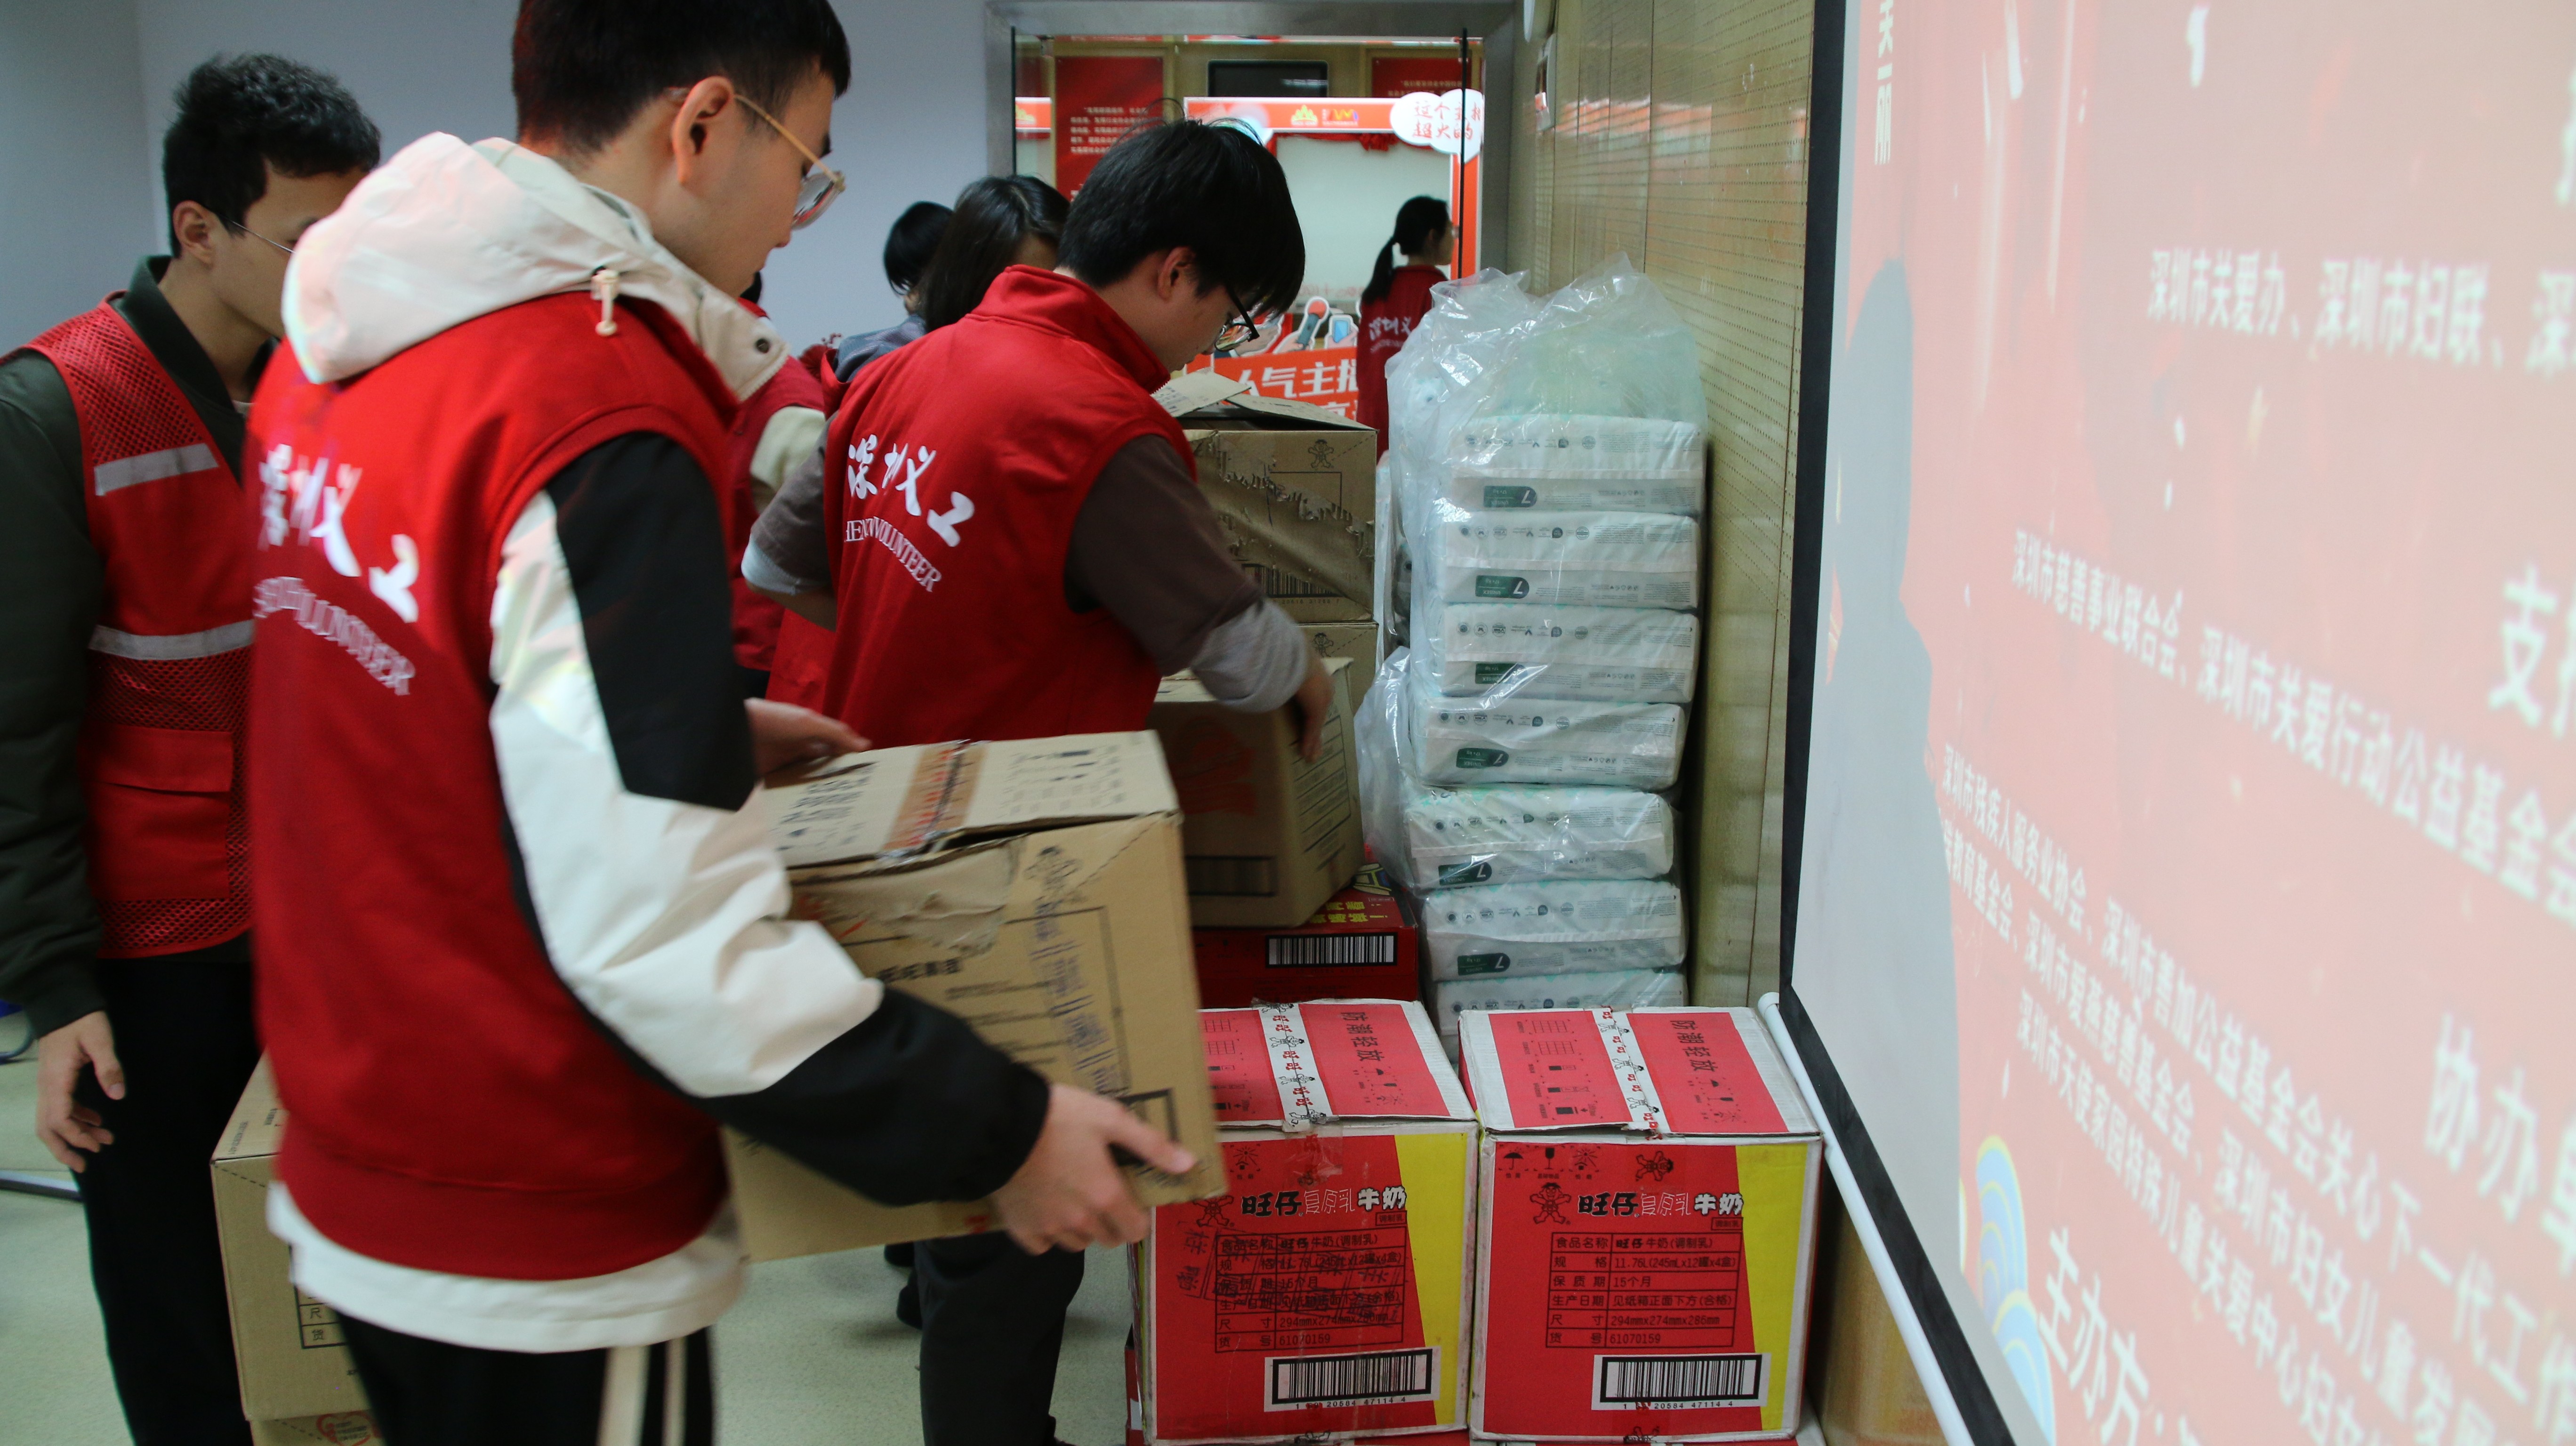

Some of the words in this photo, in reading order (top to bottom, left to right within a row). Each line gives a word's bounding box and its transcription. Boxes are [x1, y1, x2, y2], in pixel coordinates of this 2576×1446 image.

[1521, 490, 1530, 504] 7
[1513, 581, 1522, 594] 7
[1493, 754, 1502, 763] 7
[1476, 864, 1486, 877] 7
[1494, 956, 1504, 968] 7
[1340, 1012, 1384, 1062] 防潮轻放
[1670, 1019, 1719, 1073] 防潮轻放
[1556, 1237, 1609, 1250] 食品名称
[1614, 1276, 1652, 1288] 15个月
[1552, 1294, 1605, 1308] 生产日期
[1612, 1293, 1733, 1308] 见纸箱正面下方(合格)
[311, 1329, 325, 1342] 货
[1279, 1333, 1331, 1346] 61070159
[1610, 1333, 1661, 1345] 61070159
[1326, 1400, 1357, 1408] 20584
[1363, 1397, 1394, 1405] 47114
